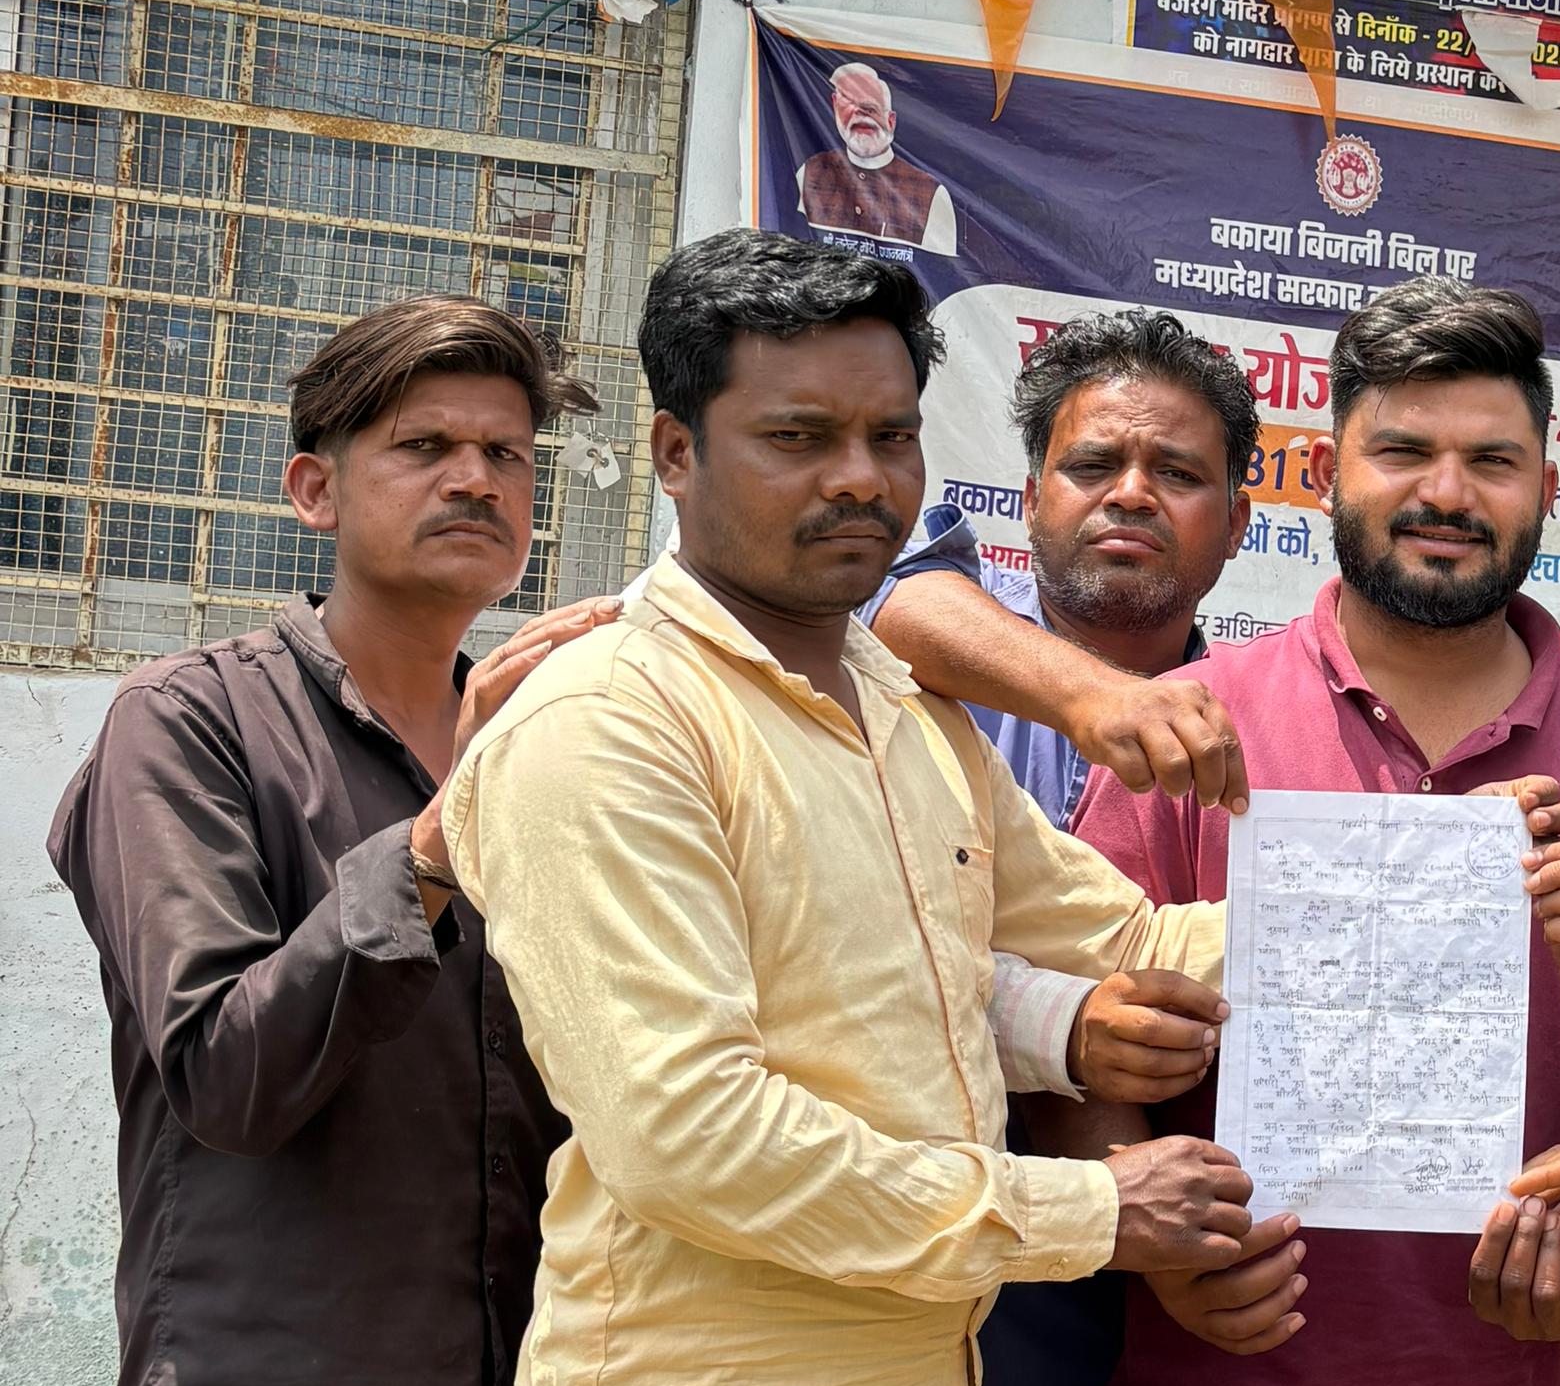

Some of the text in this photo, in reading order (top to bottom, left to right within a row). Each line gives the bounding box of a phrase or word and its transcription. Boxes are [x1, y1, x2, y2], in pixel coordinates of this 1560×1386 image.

[1335, 8, 1353, 36] से
[1193, 26, 1221, 55] को
[1225, 36, 1295, 64] नागद्वार
[1346, 46, 1366, 73] के
[1371, 49, 1412, 80] लिये
[1416, 61, 1476, 90] प्रस्थान
[1210, 217, 1477, 280] बकाया बिजली बिल पर
[1154, 258, 1272, 301] मध्यप्रदेश
[1276, 272, 1365, 312] सरकार
